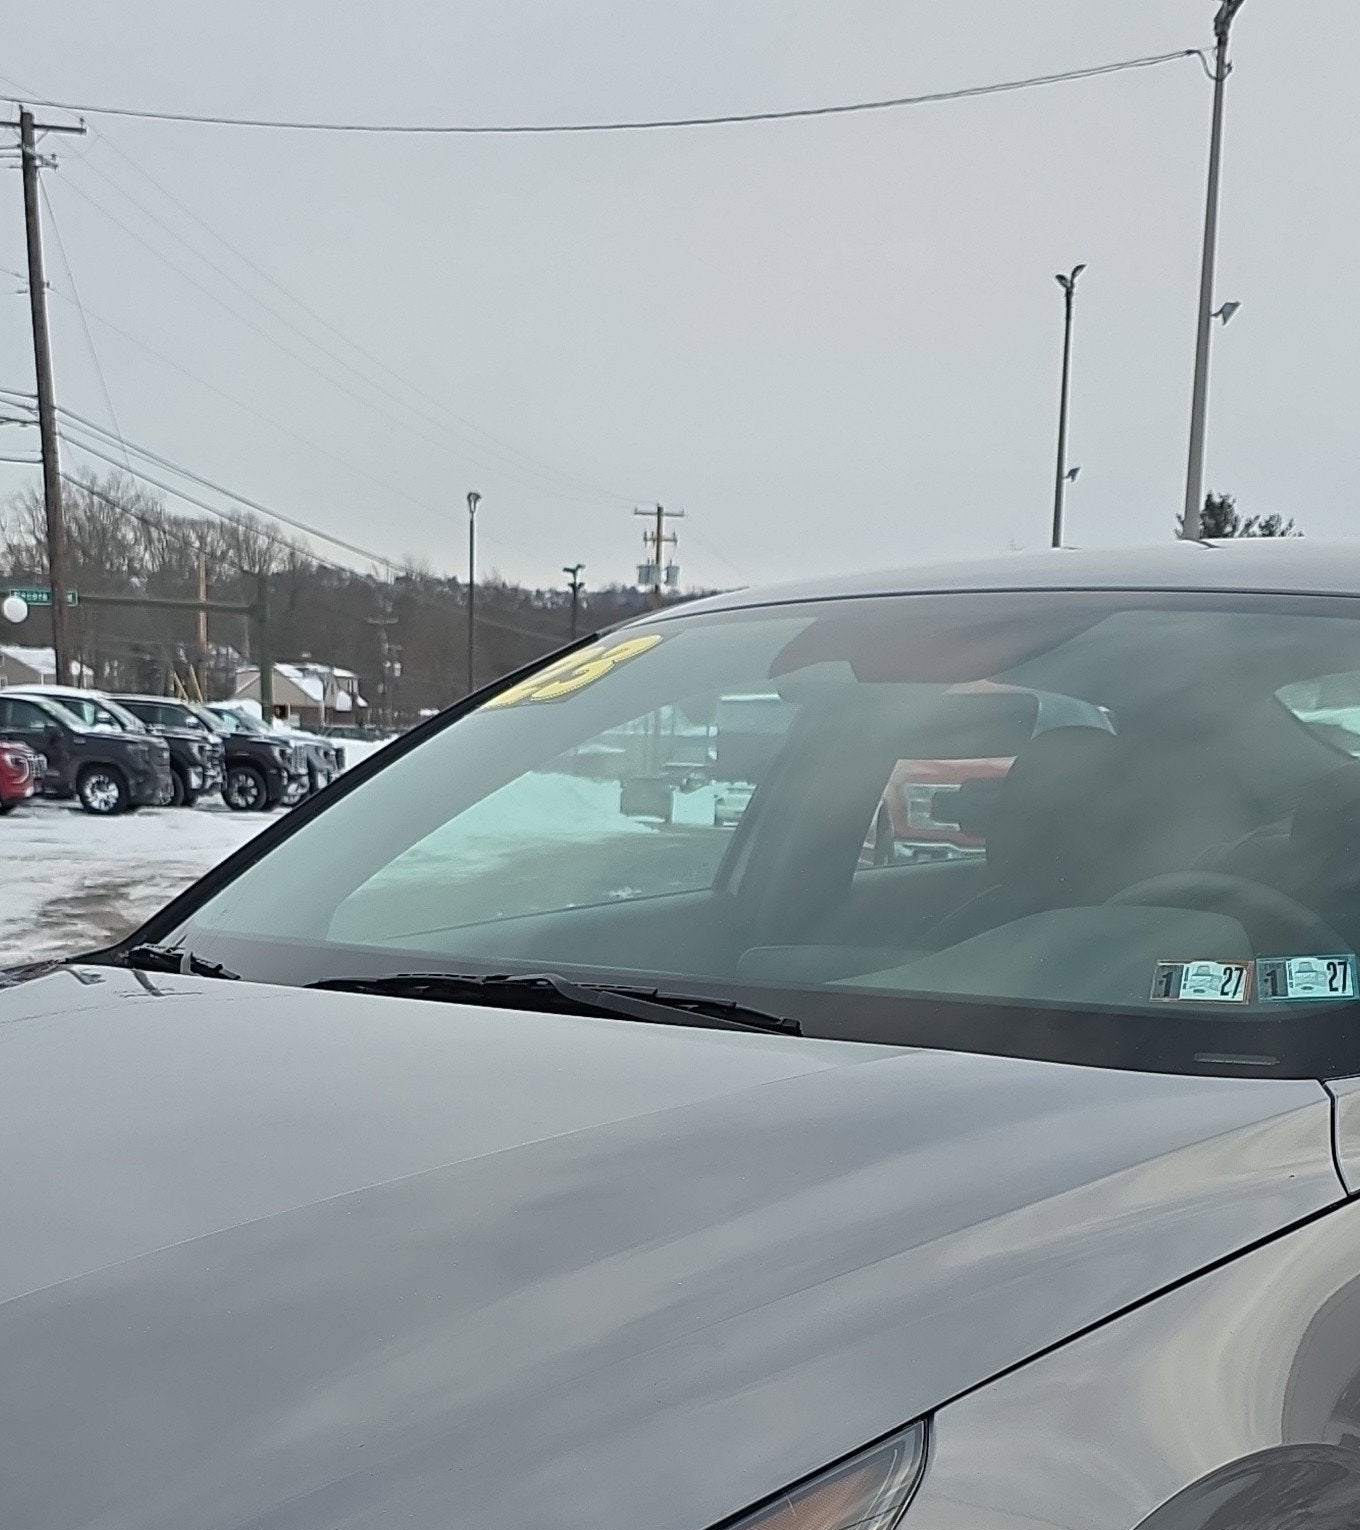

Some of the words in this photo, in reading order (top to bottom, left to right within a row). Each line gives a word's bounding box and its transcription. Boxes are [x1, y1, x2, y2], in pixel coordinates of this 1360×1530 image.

[487, 634, 664, 708] 23
[1219, 966, 1245, 999] 27
[1326, 961, 1348, 994] 27
